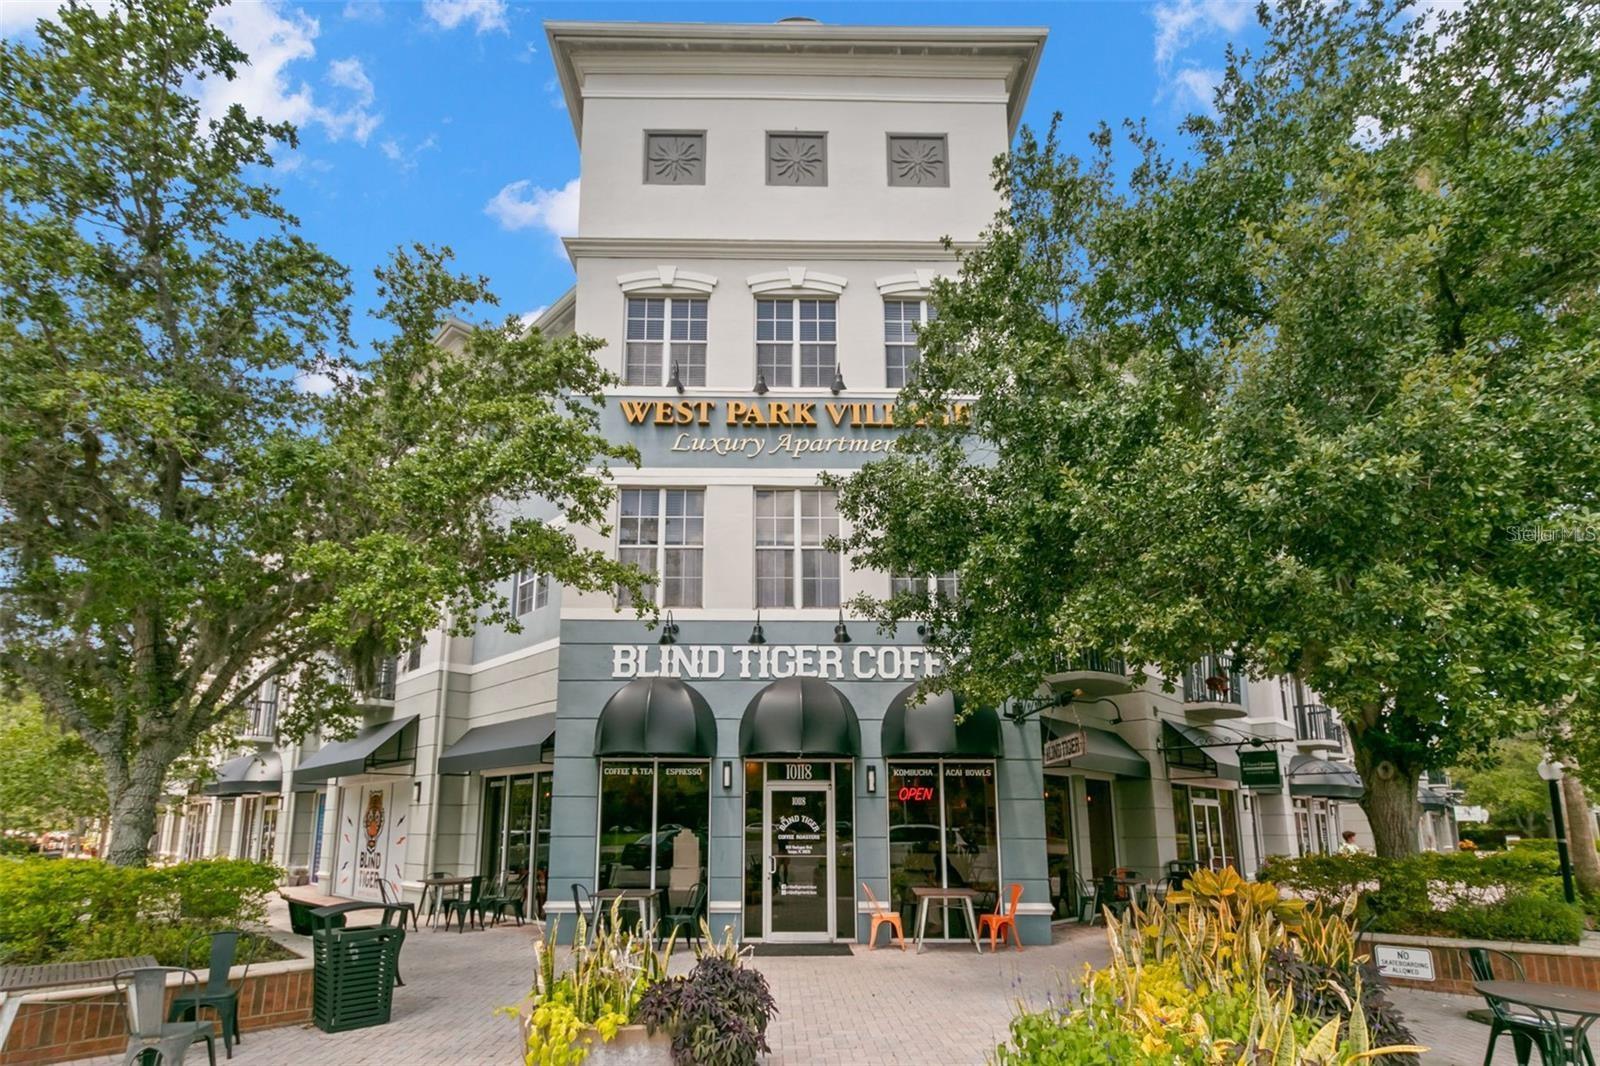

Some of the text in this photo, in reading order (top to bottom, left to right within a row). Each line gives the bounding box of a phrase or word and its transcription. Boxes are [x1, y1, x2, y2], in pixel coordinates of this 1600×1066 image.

[619, 399, 716, 427] WEST
[726, 401, 818, 428] PARK
[670, 432, 921, 459] Luxury Apartmen
[611, 645, 727, 679] BLIND
[732, 645, 846, 679] TIGER
[603, 767, 630, 776] COFFEE
[640, 767, 654, 776] TEA
[665, 767, 703, 776] ESPRESSO
[785, 763, 813, 780] 10118
[893, 768, 934, 777] KOMBUCHA
[965, 768, 992, 777] BOWLS
[898, 786, 934, 801] OPEN
[779, 814, 821, 833] BLIND TIGER
[359, 851, 381, 870] BLIND
[359, 870, 380, 889] TIGER
[1396, 951, 1410, 961] NO
[1380, 959, 1430, 970] SKATEBOARDING
[1392, 966, 1420, 976] ALLOWED
